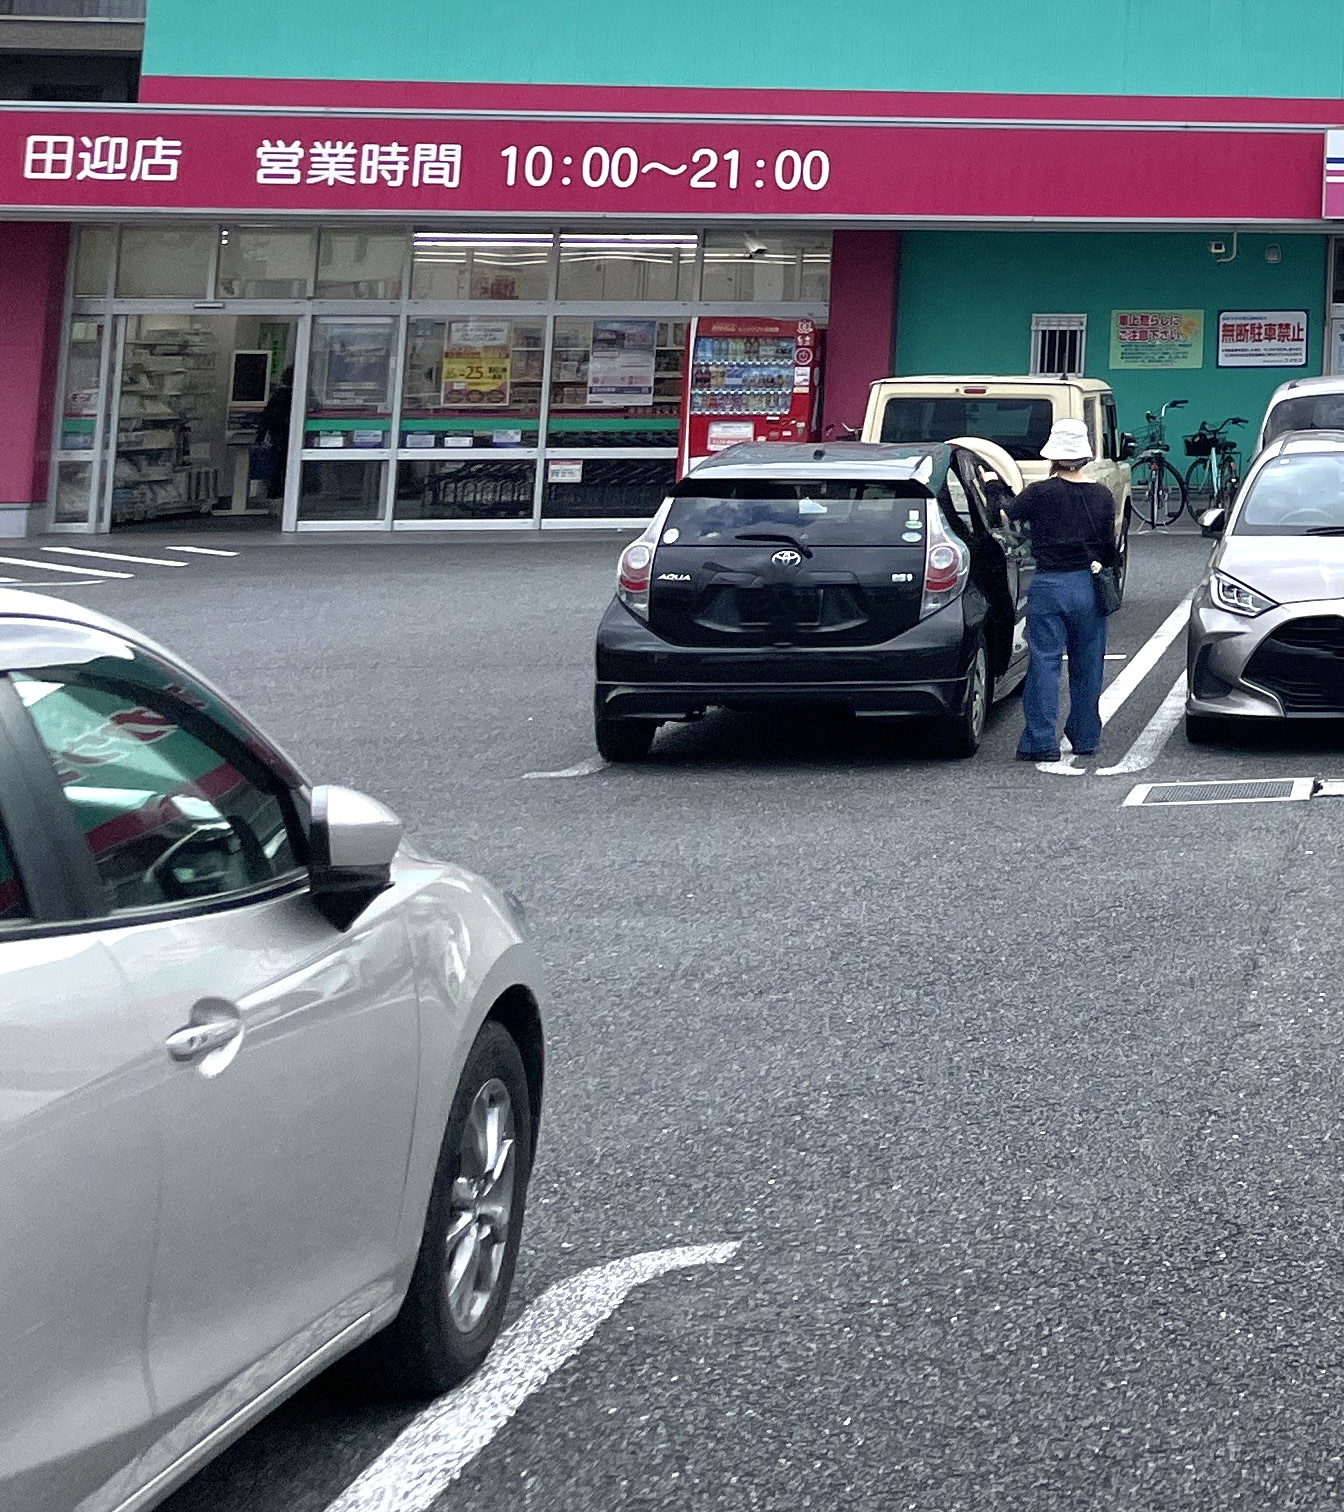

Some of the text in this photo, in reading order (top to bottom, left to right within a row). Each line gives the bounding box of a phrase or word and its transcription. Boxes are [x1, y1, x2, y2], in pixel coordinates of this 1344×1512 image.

[23, 134, 832, 192] 田迎店 営業時間 10:00～21:00
[1221, 321, 1305, 344] 無断駐車禁止
[658, 573, 691, 581] AQUA
